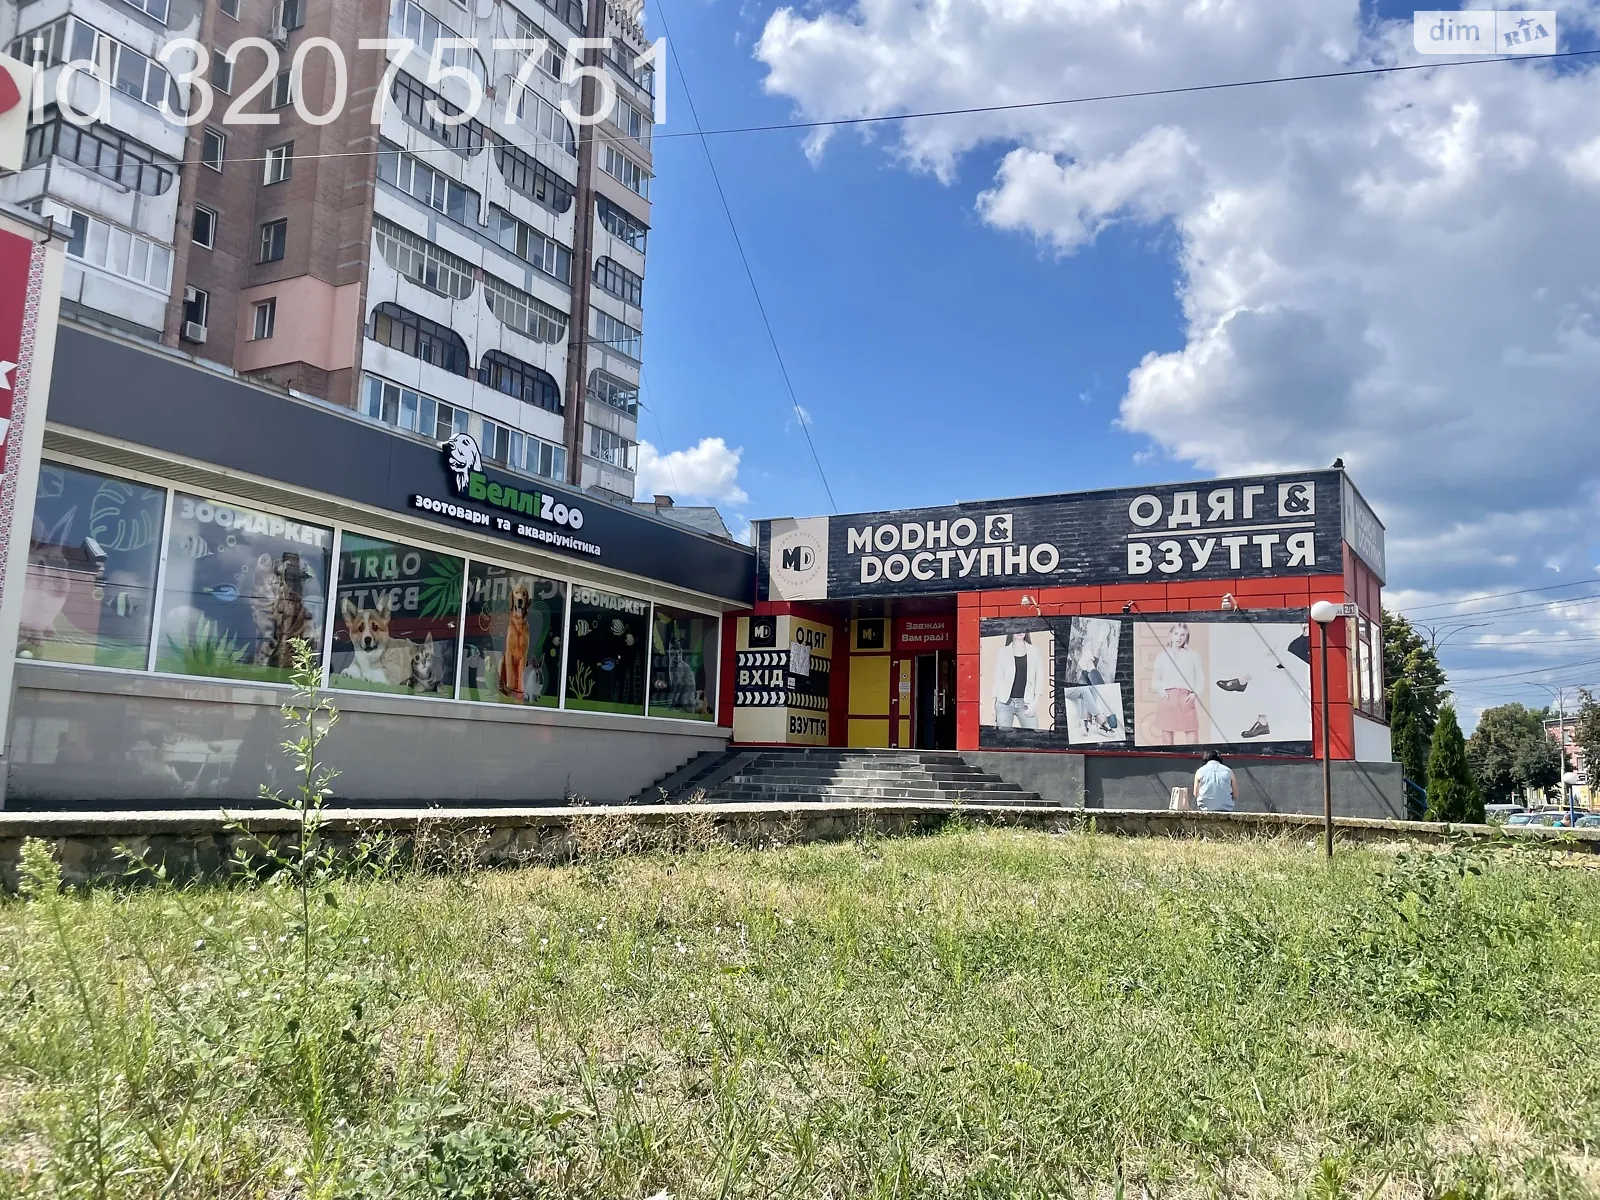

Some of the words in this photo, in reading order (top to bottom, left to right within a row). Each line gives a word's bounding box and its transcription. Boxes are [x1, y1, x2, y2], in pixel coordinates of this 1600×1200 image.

[468, 472, 584, 529] БелліZoo
[1128, 485, 1266, 529] ОДЯГ
[180, 499, 326, 547] ЗООМАРКЕТ
[415, 495, 490, 526] зоотовари
[497, 517, 511, 531] та
[517, 524, 601, 556] акваріумістика
[782, 545, 815, 571] MD
[1127, 531, 1317, 575] ВЗУТТЯ
[573, 587, 647, 615] ЗООМАРКЕТ
[754, 625, 772, 638] MD
[796, 627, 827, 649] ОДЯГ
[901, 633, 922, 642] Вам
[923, 632, 944, 643] раді
[905, 622, 945, 630] Завжди
[739, 669, 784, 688] ВХІД
[789, 715, 827, 736] ВЗУТТЯ
